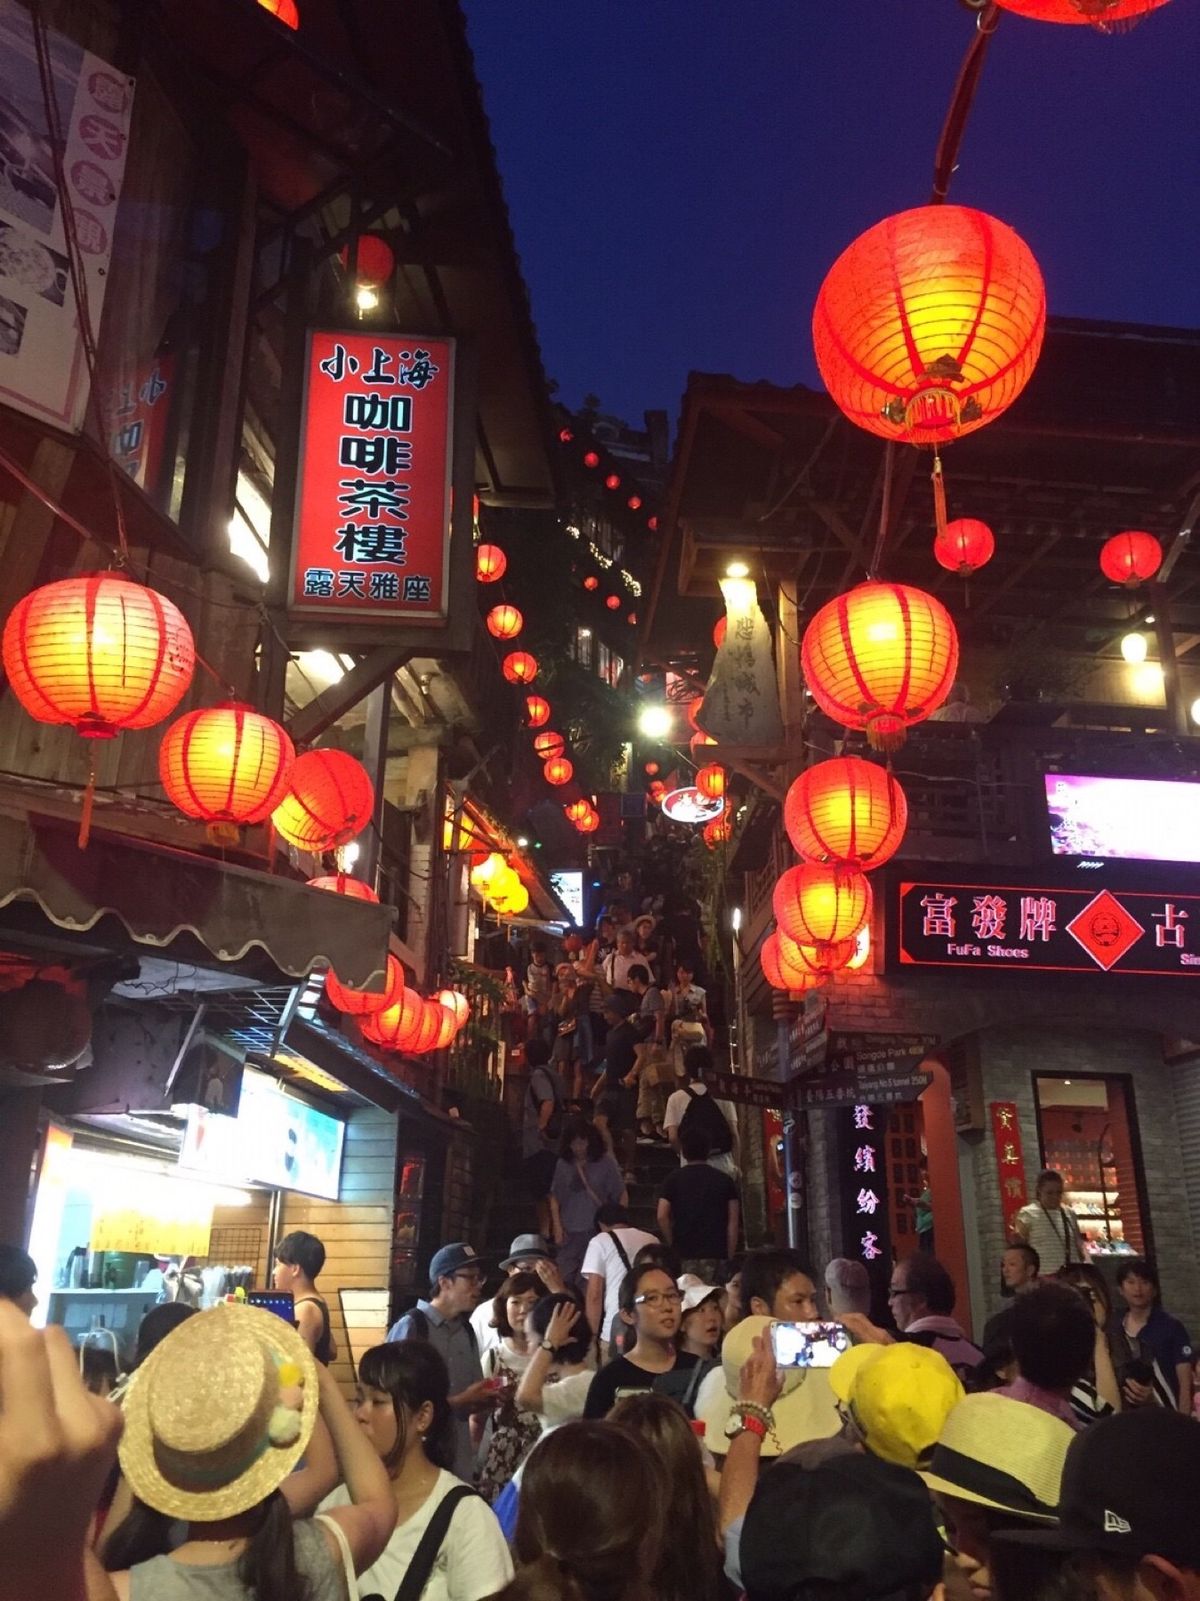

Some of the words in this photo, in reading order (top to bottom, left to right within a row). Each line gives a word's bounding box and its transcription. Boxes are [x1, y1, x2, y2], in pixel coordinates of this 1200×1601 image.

[320, 343, 440, 390] 小上海
[333, 393, 414, 566] 咖啡茶樓
[304, 568, 431, 602] 露天雅座
[920, 893, 1057, 941] 富發牌
[1151, 903, 1189, 948] 古
[947, 943, 982, 957] FuFa
[987, 945, 1030, 959] Shoes
